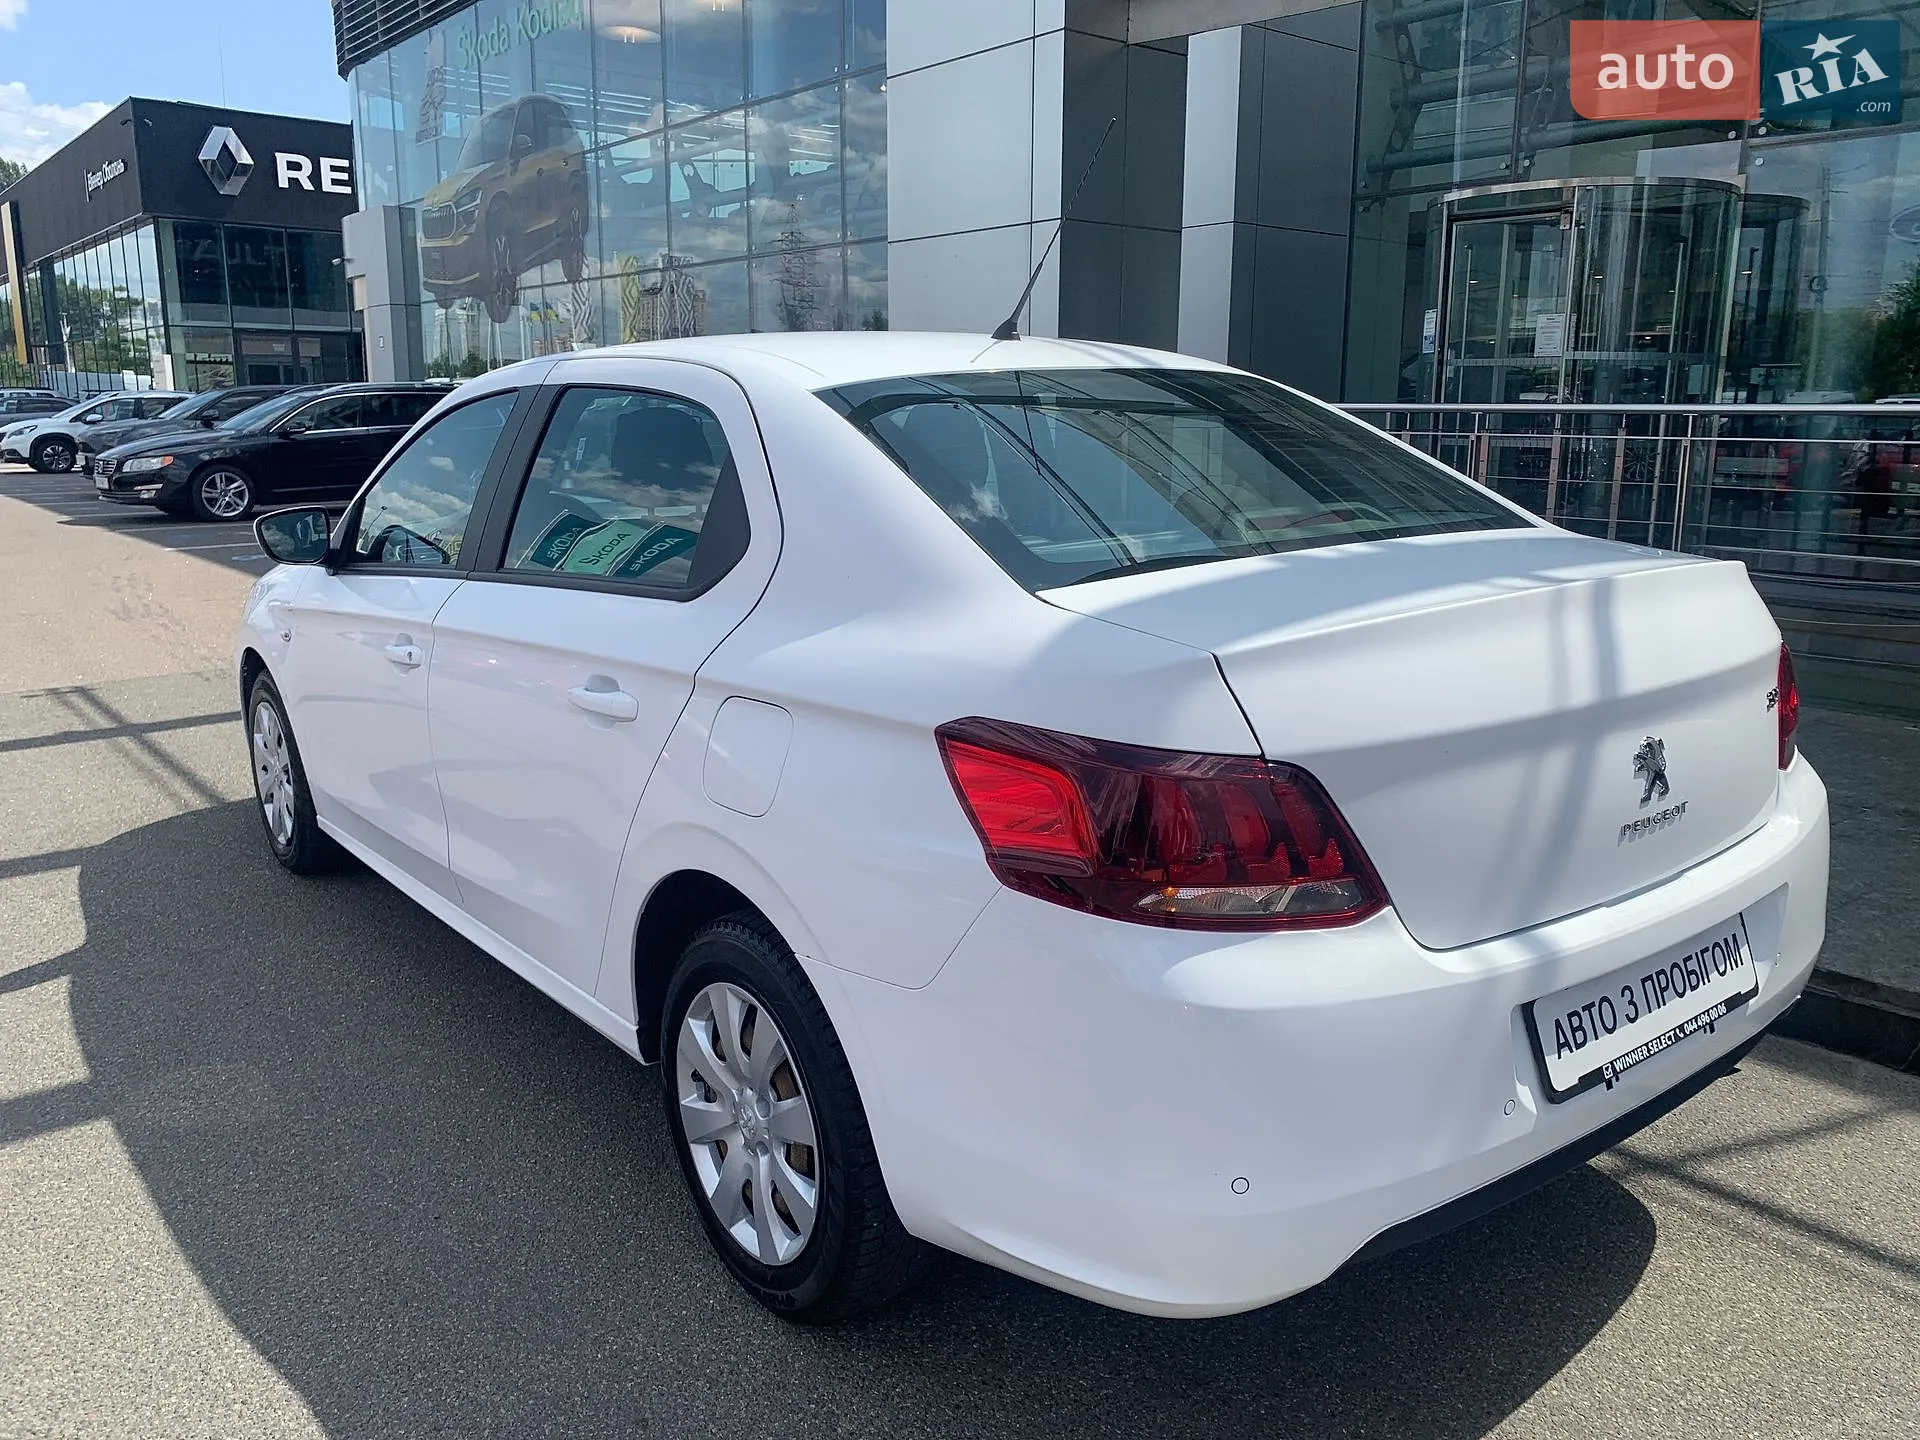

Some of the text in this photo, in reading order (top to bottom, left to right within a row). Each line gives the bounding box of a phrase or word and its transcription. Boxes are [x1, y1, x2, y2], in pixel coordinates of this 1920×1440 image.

[1621, 801, 1688, 836] PEUGEOT
[1554, 995, 1618, 1060] АВТО
[1640, 932, 1744, 1014] ПРОБІГОМ
[1613, 1046, 1649, 1073] WINNER
[1648, 1030, 1677, 1055] SELECT
[1683, 1019, 1698, 1035] 044
